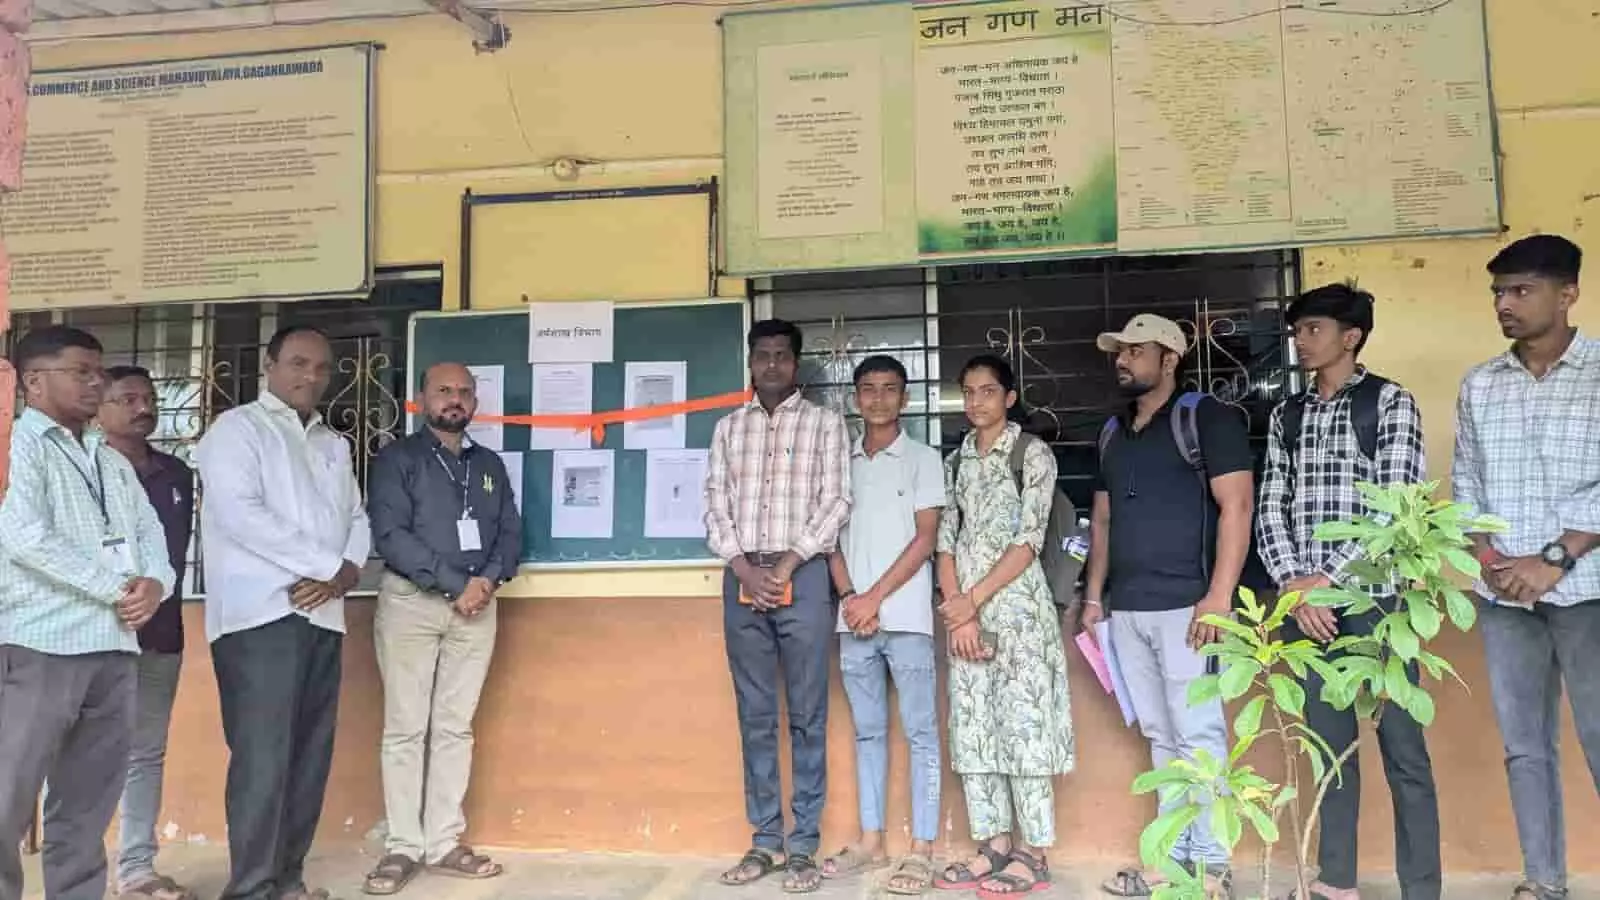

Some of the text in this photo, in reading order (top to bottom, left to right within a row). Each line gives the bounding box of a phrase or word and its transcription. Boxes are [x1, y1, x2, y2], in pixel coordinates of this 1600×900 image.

[919, 4, 1105, 39] जन गण मन
[32, 81, 88, 96] COMMERCE
[91, 79, 113, 92] AND
[114, 75, 156, 90] SCIENCE
